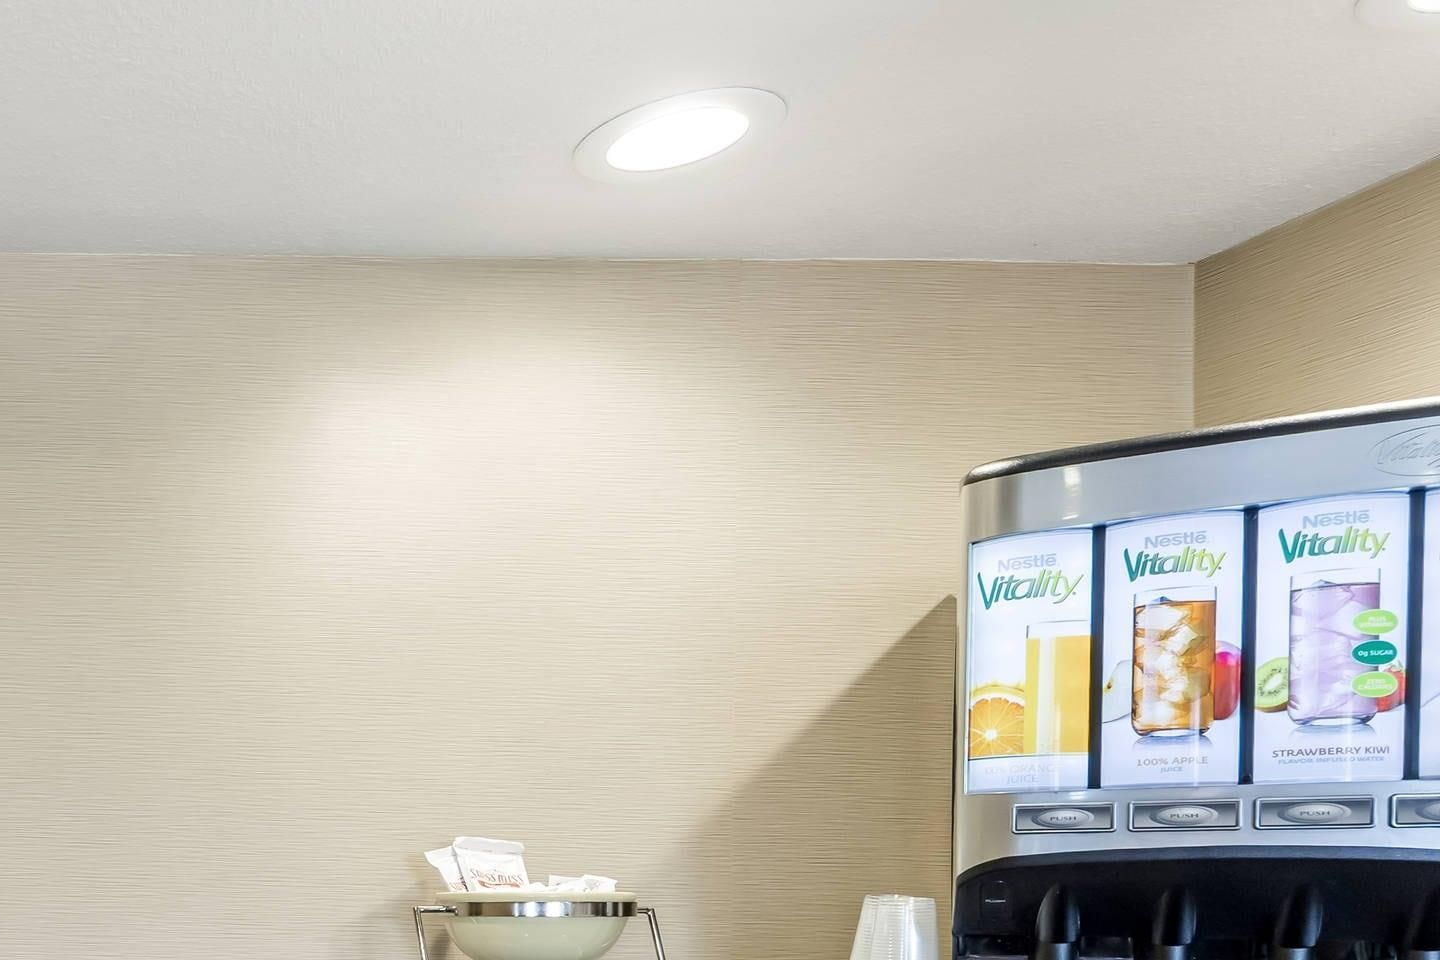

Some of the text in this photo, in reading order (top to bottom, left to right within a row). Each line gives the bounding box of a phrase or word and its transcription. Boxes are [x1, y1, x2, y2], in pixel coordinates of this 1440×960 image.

[1278, 526, 1391, 564] Vitality
[1124, 546, 1227, 582] Vitality
[977, 569, 1084, 610] Vitality
[1136, 755, 1209, 767] 100% APPLE
[1272, 746, 1390, 758] STRAWBERRY KIWI
